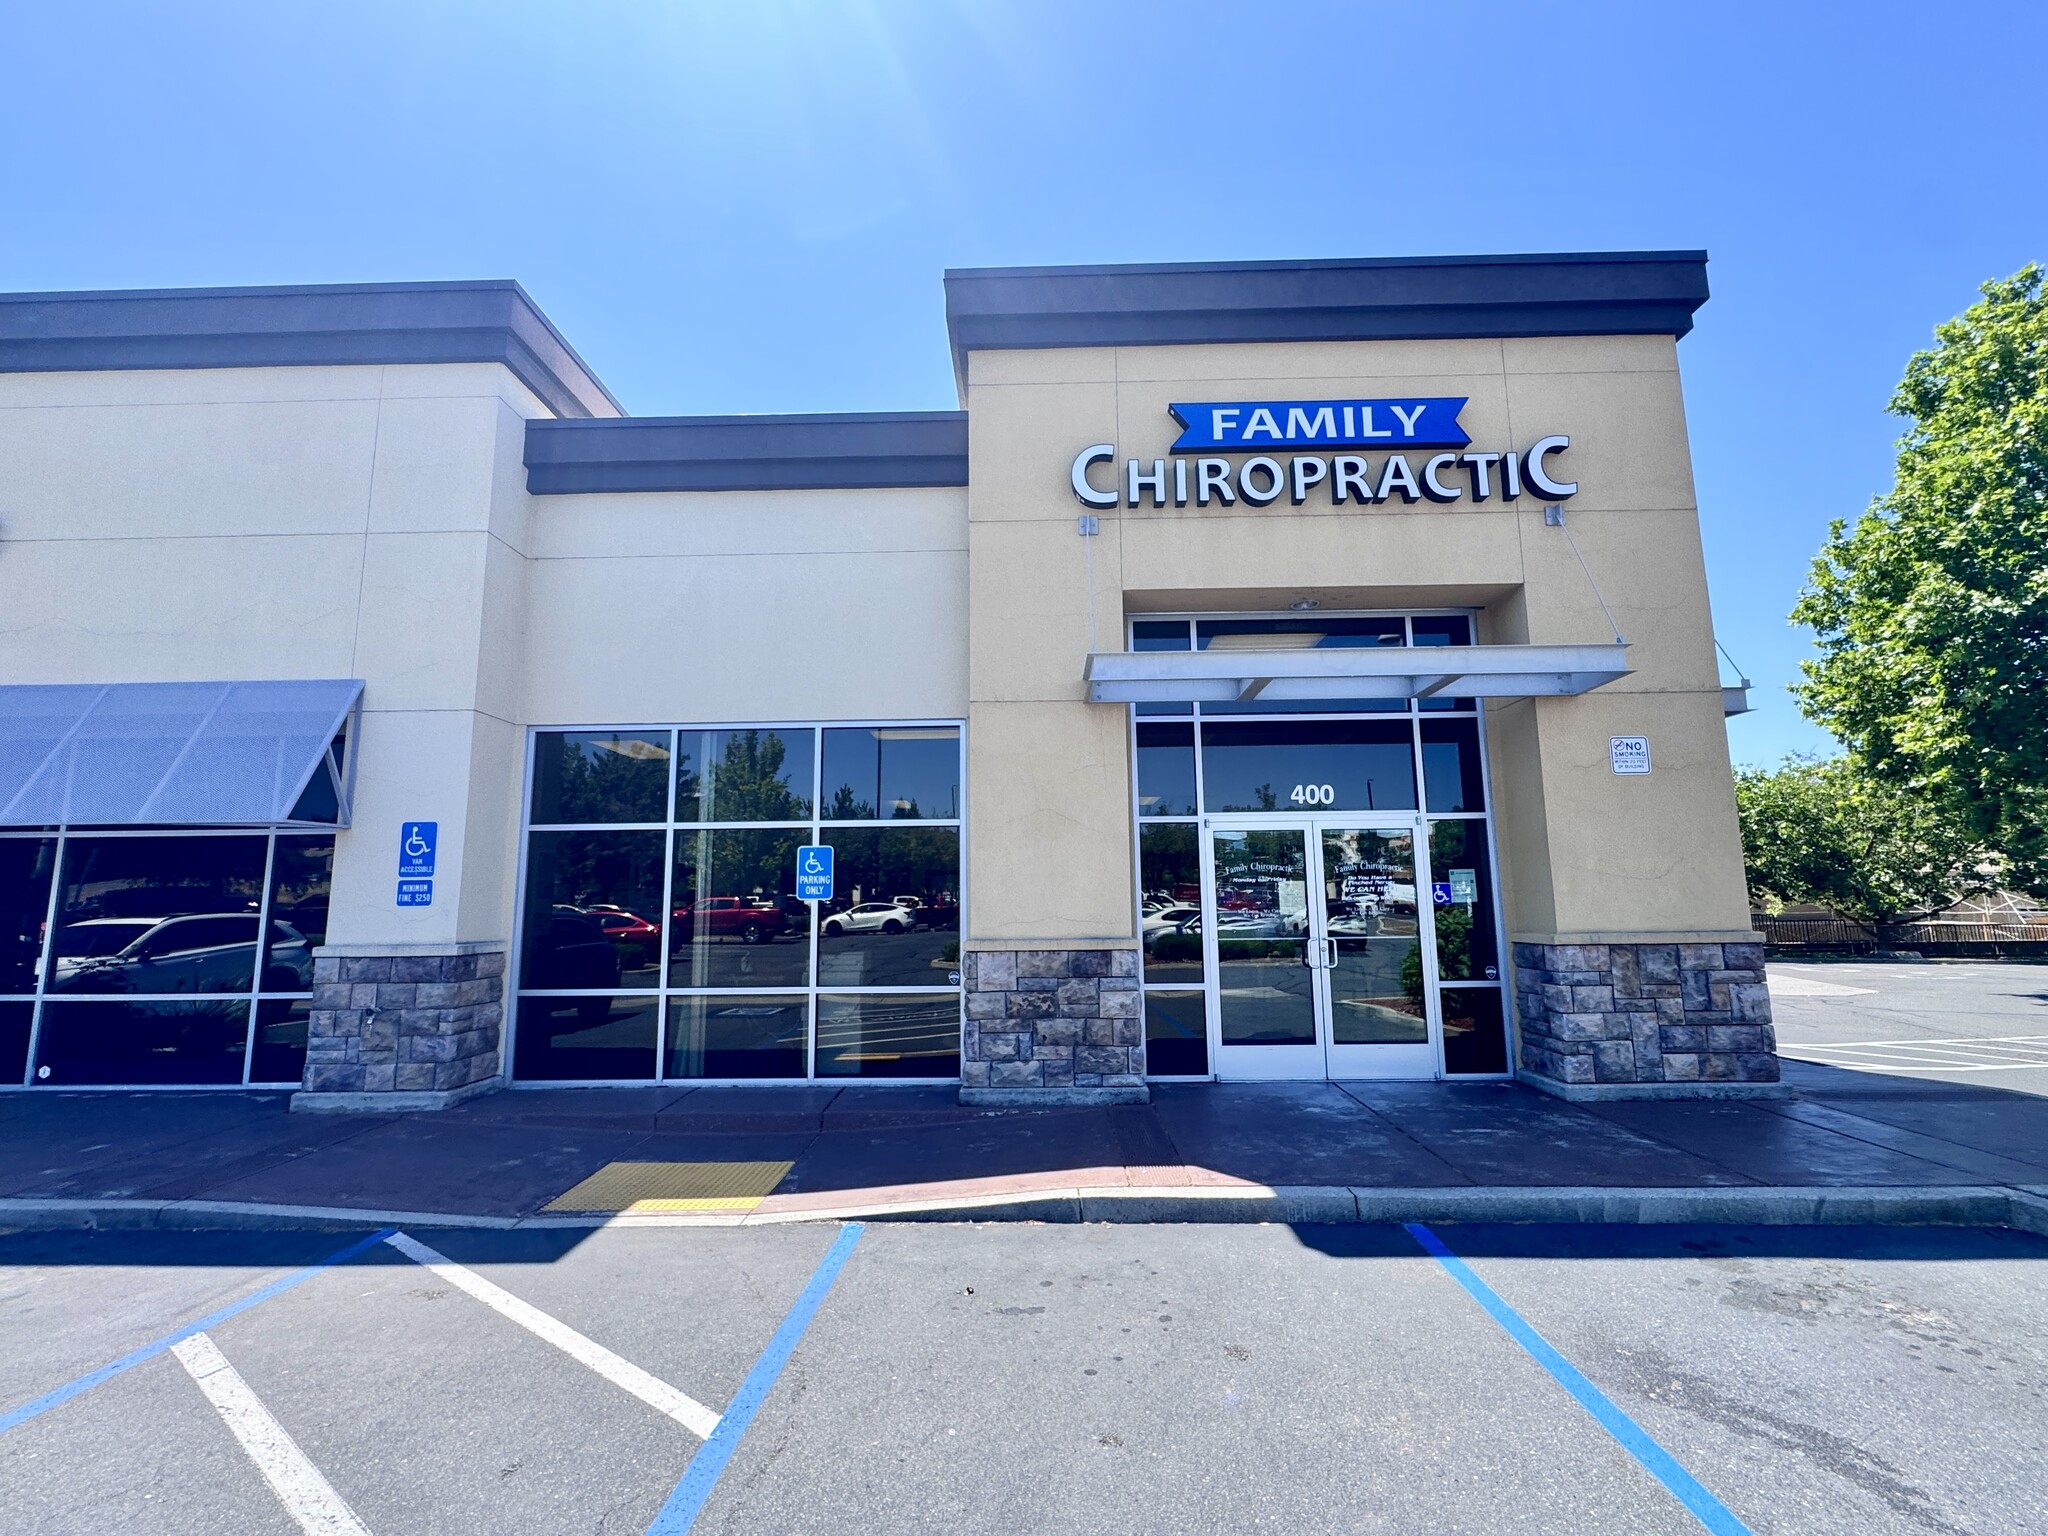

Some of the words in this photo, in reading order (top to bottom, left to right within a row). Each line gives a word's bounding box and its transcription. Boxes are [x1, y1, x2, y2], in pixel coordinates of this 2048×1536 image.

[1211, 405, 1427, 440] FAMILY
[1070, 435, 1579, 508] CHIROPRACTIC
[1626, 742, 1642, 750] NO
[1290, 784, 1335, 805] 400
[1225, 864, 1248, 875] Family
[1250, 862, 1294, 874] Chiropractic
[1334, 864, 1358, 874] Family
[1360, 859, 1404, 872] Chiropractic
[800, 875, 831, 884] PARKING
[402, 884, 428, 892] MINIMUM
[805, 885, 824, 895] ONLY
[398, 894, 412, 902] FINE
[415, 894, 431, 902] $250
